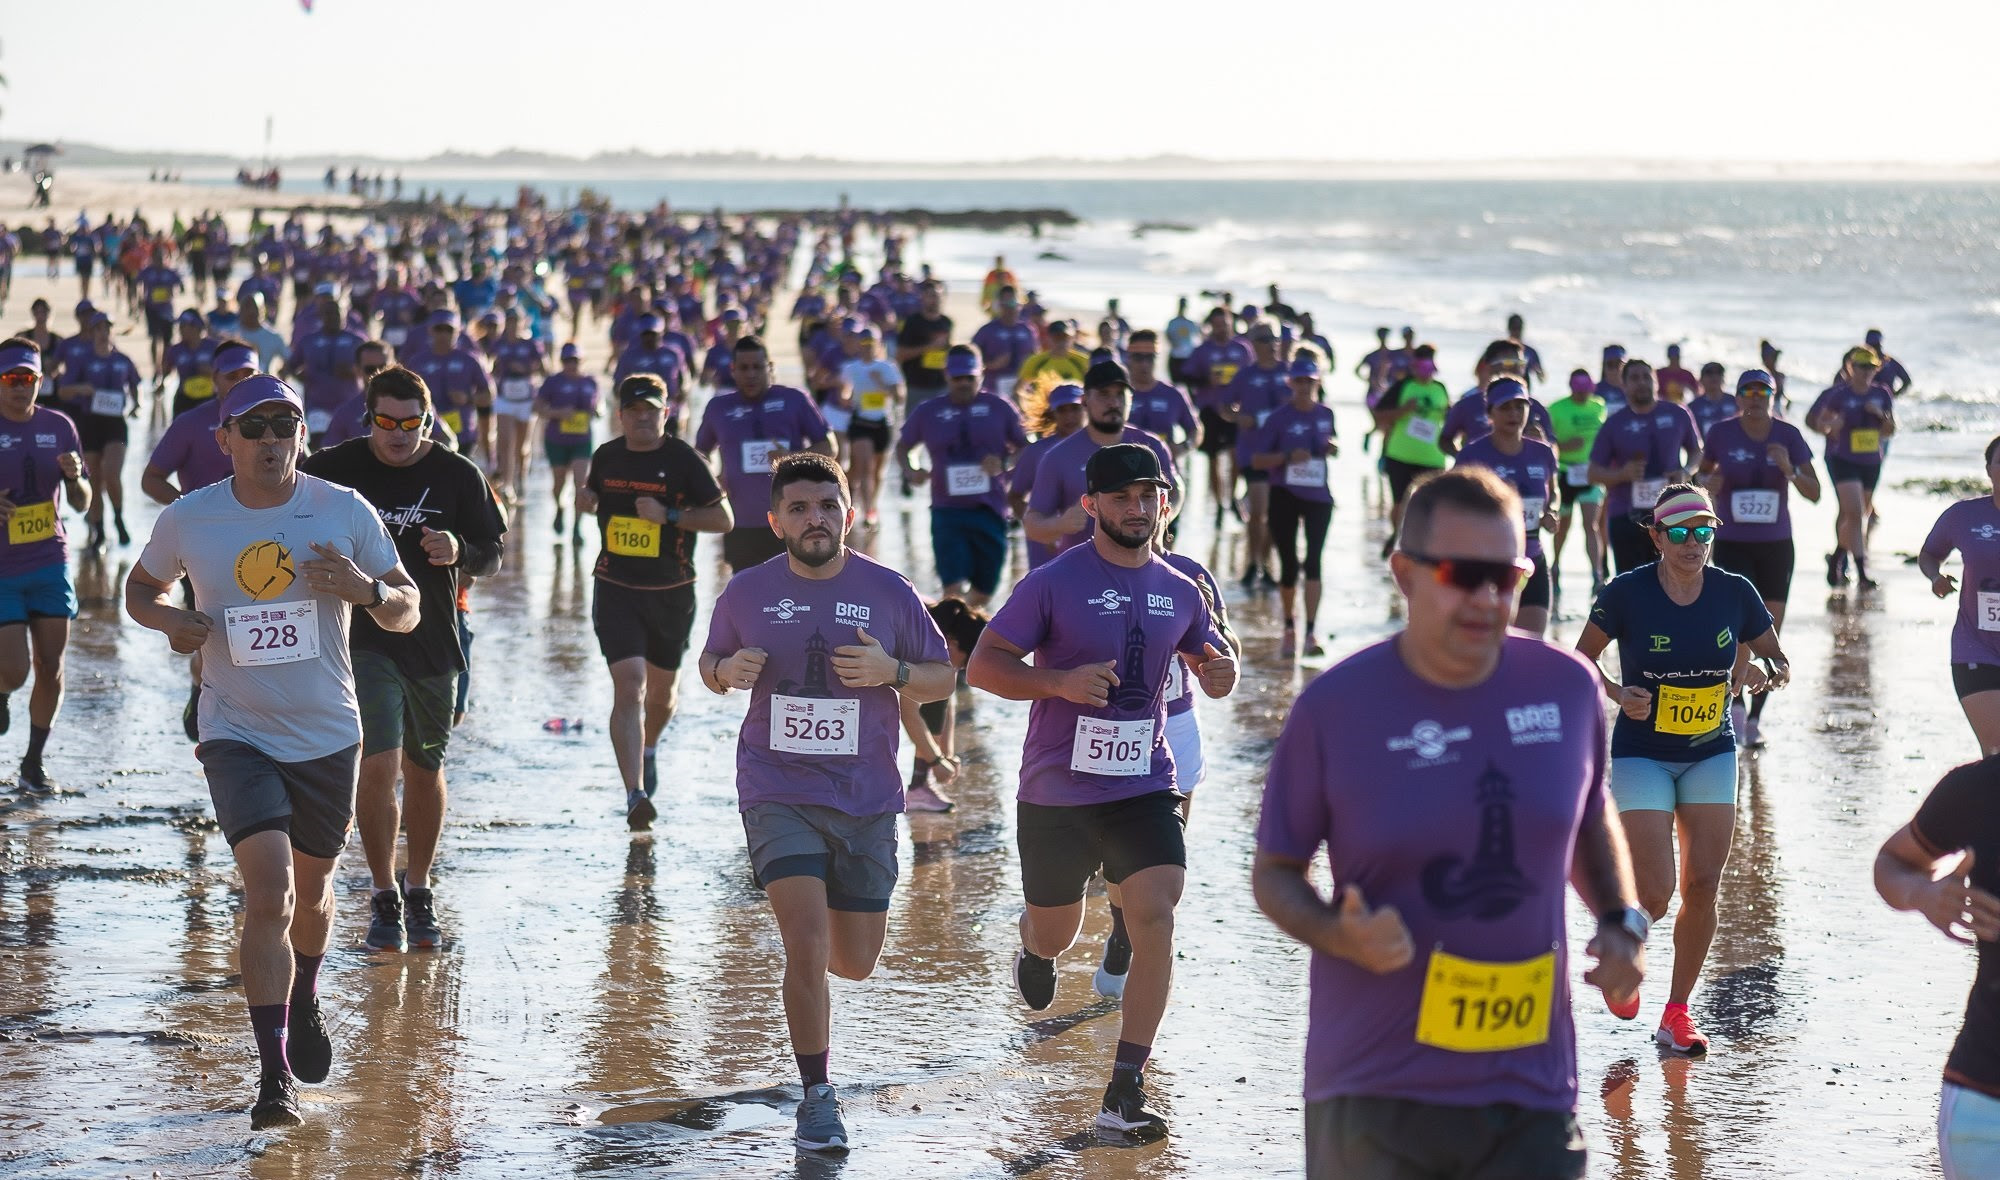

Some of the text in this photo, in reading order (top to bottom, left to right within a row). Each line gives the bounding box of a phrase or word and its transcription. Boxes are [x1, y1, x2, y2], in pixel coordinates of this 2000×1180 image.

[378, 487, 442, 535] rowth
[1739, 503, 1772, 515] 5222
[17, 517, 51, 536] 1204
[613, 531, 651, 548] 1180
[763, 605, 781, 613] BEACH
[1087, 597, 1106, 605] BEACH
[835, 617, 870, 628] PARACURU
[1148, 608, 1175, 618] PARACURU
[248, 624, 299, 651] 228
[1669, 702, 1718, 724] 1048
[784, 716, 845, 741] 5263
[1087, 738, 1142, 762] 5105
[1448, 993, 1536, 1031] 1190
